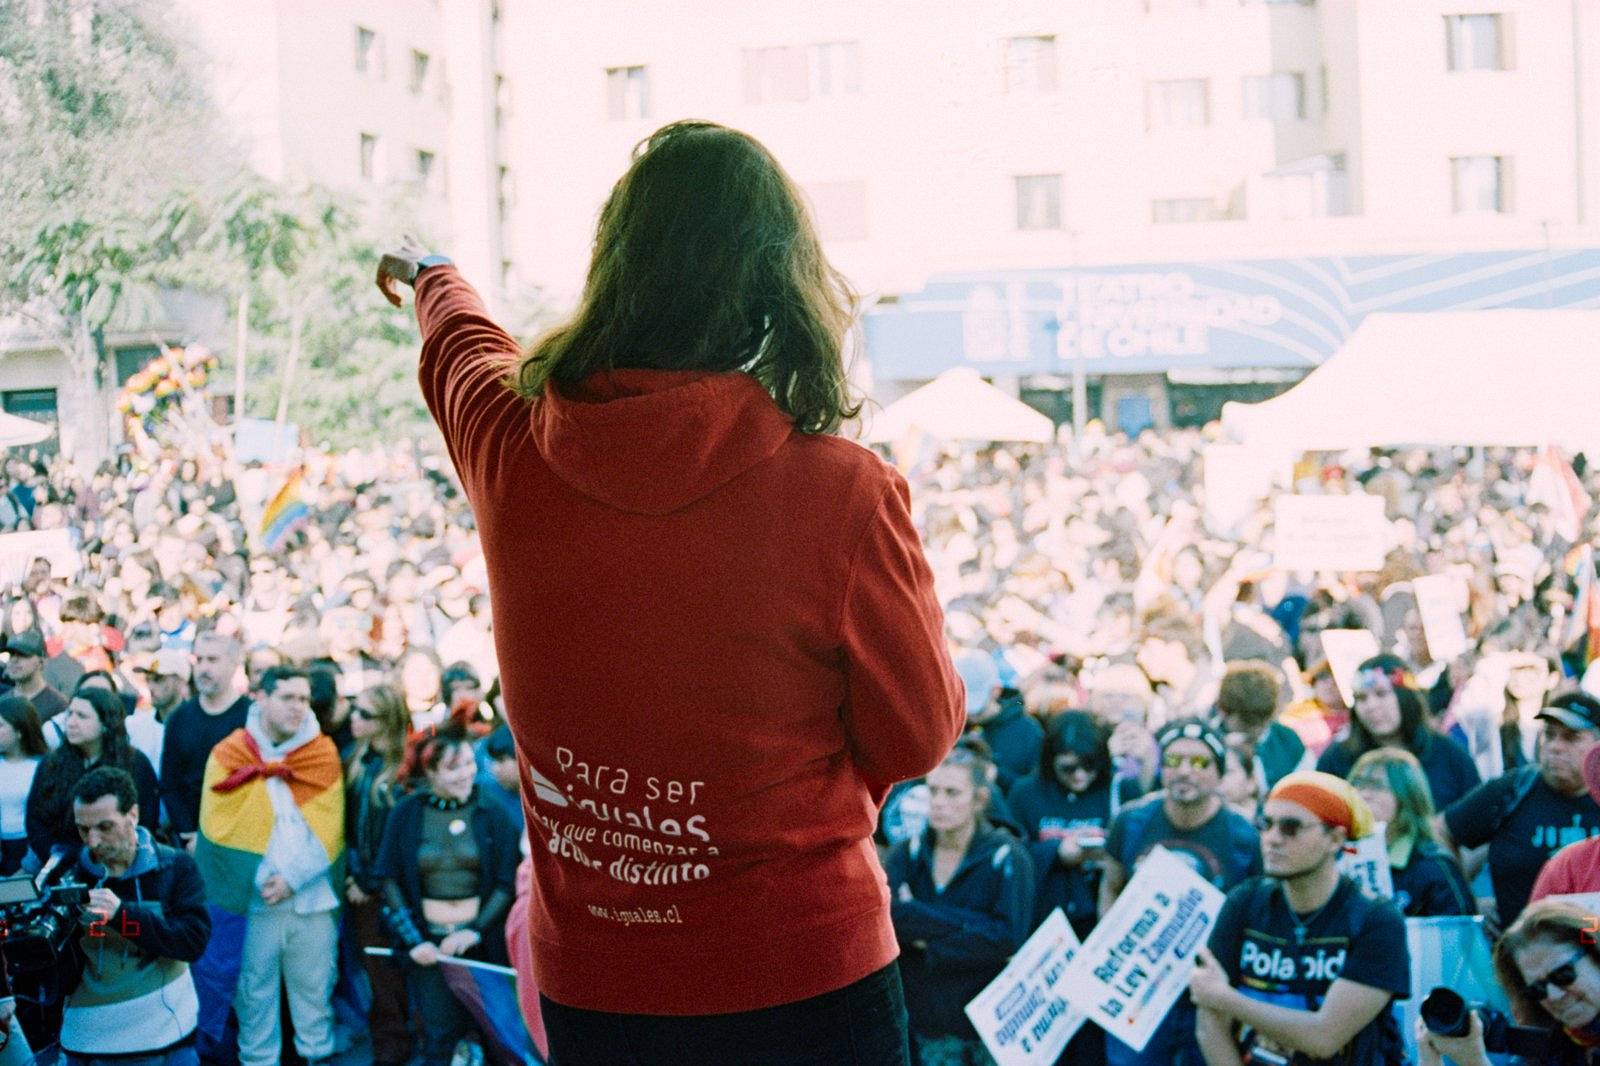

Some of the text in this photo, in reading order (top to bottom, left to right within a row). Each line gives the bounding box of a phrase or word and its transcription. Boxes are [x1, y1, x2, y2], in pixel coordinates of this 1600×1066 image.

[646, 777, 705, 805] ser
[563, 823, 597, 844] que
[602, 829, 698, 856] comenzar
[609, 854, 710, 885] distinto
[1093, 907, 1160, 984] Reforma
[1155, 892, 1170, 908] a
[1099, 997, 1125, 1018] la
[1114, 965, 1149, 998] Ley
[1140, 887, 1204, 965] Zamudio
[1241, 940, 1347, 979] Polaoid
